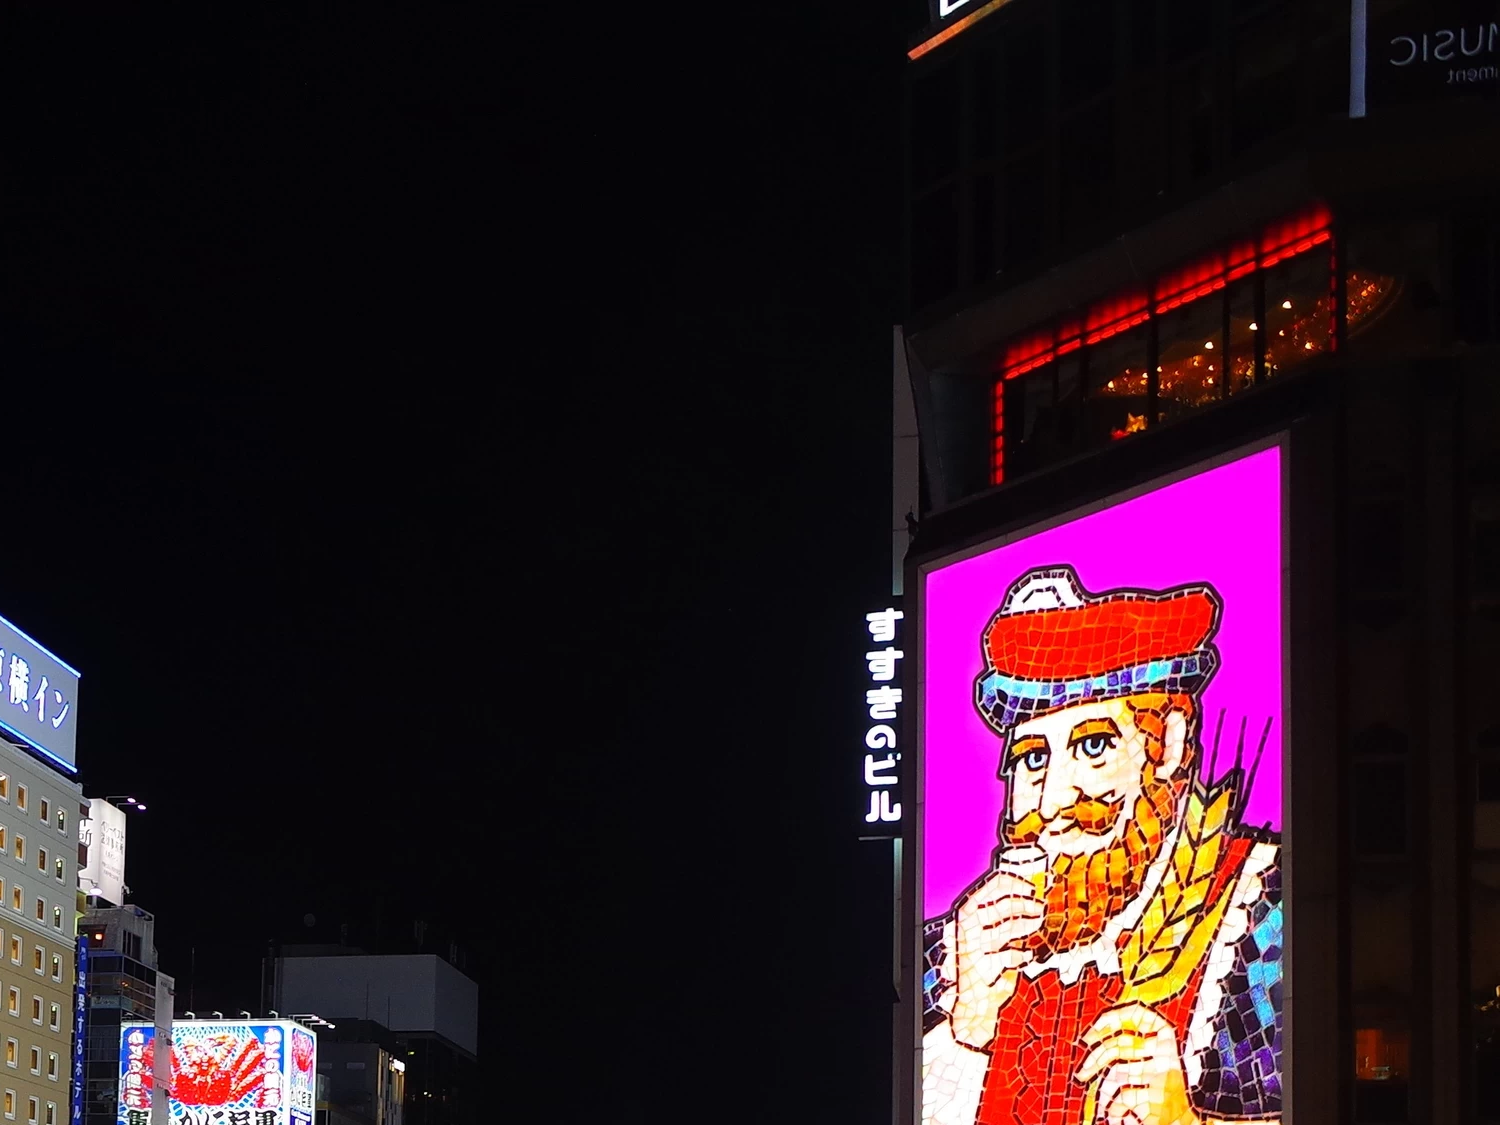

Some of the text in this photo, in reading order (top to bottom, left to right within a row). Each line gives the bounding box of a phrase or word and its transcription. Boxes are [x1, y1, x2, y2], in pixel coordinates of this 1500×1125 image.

[865, 608, 904, 823] すすきのビル
